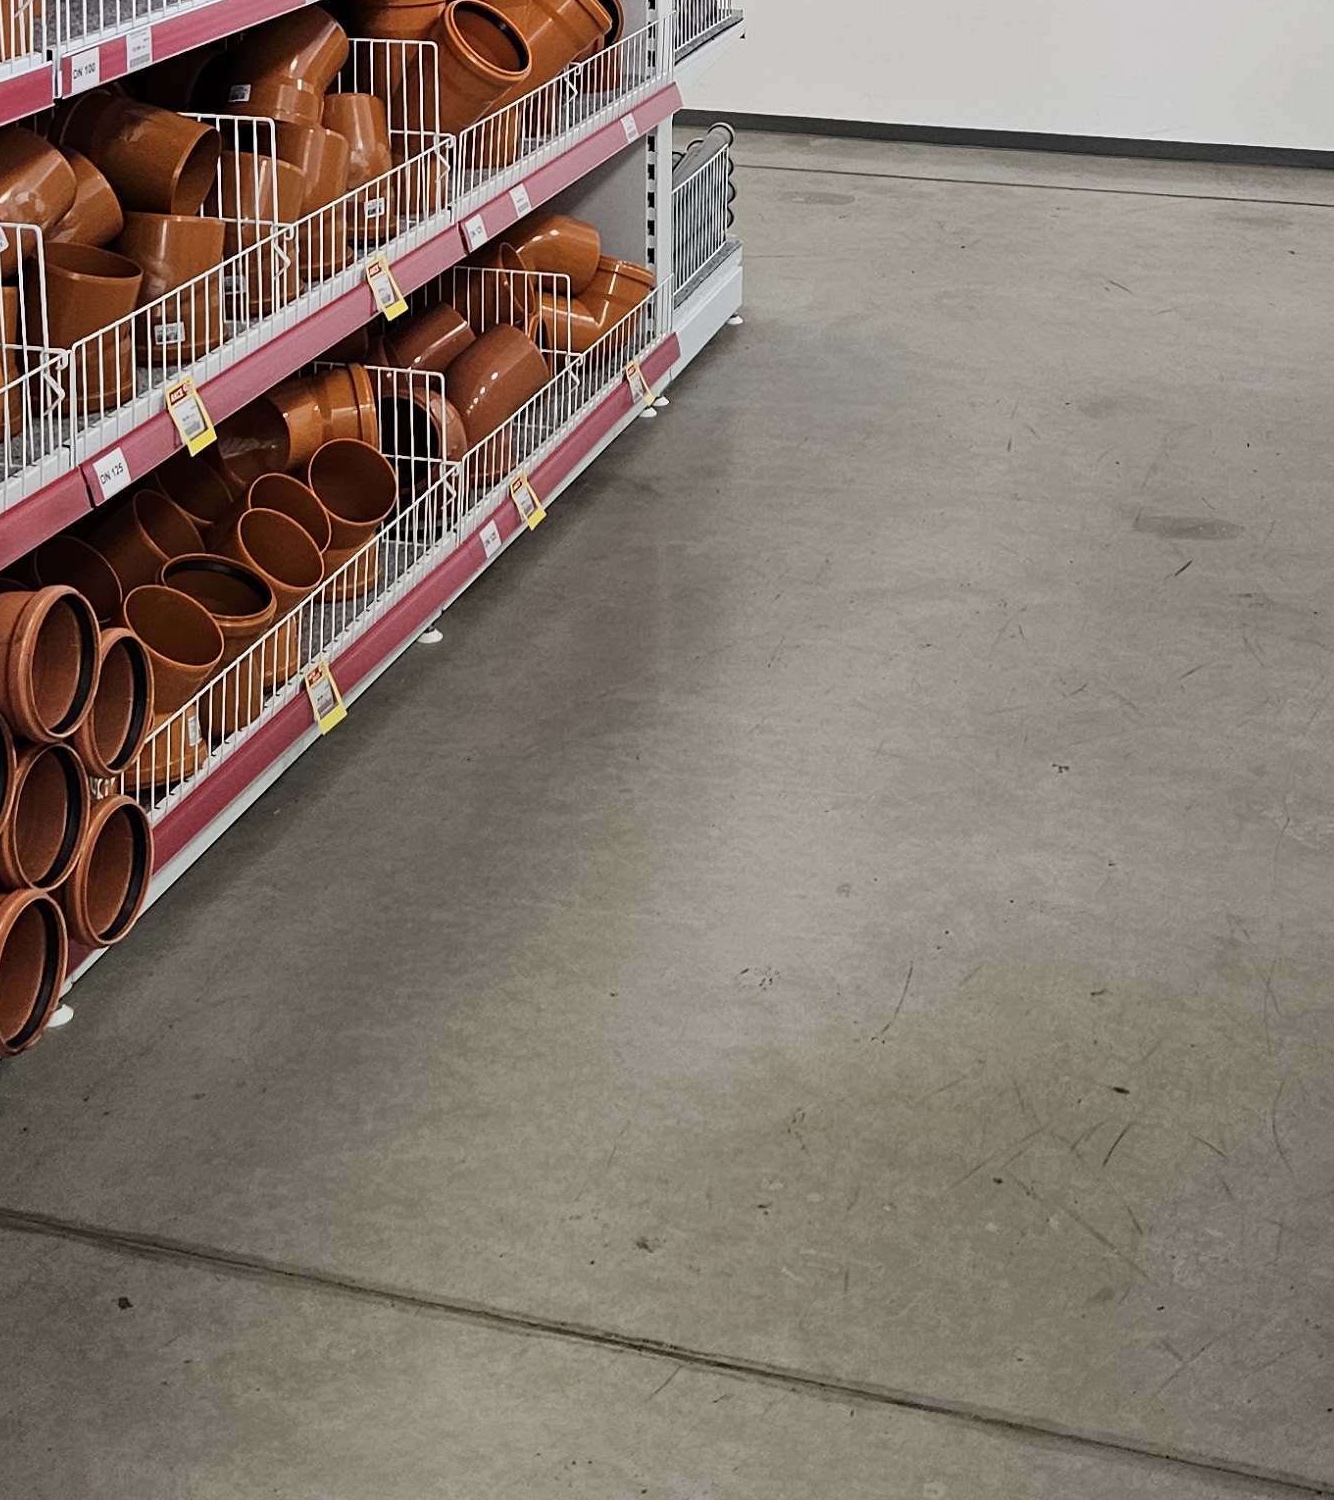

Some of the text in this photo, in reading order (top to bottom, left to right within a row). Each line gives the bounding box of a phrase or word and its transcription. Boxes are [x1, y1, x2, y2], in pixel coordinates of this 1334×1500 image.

[73, 66, 83, 79] DN
[99, 462, 124, 485] DN 125
